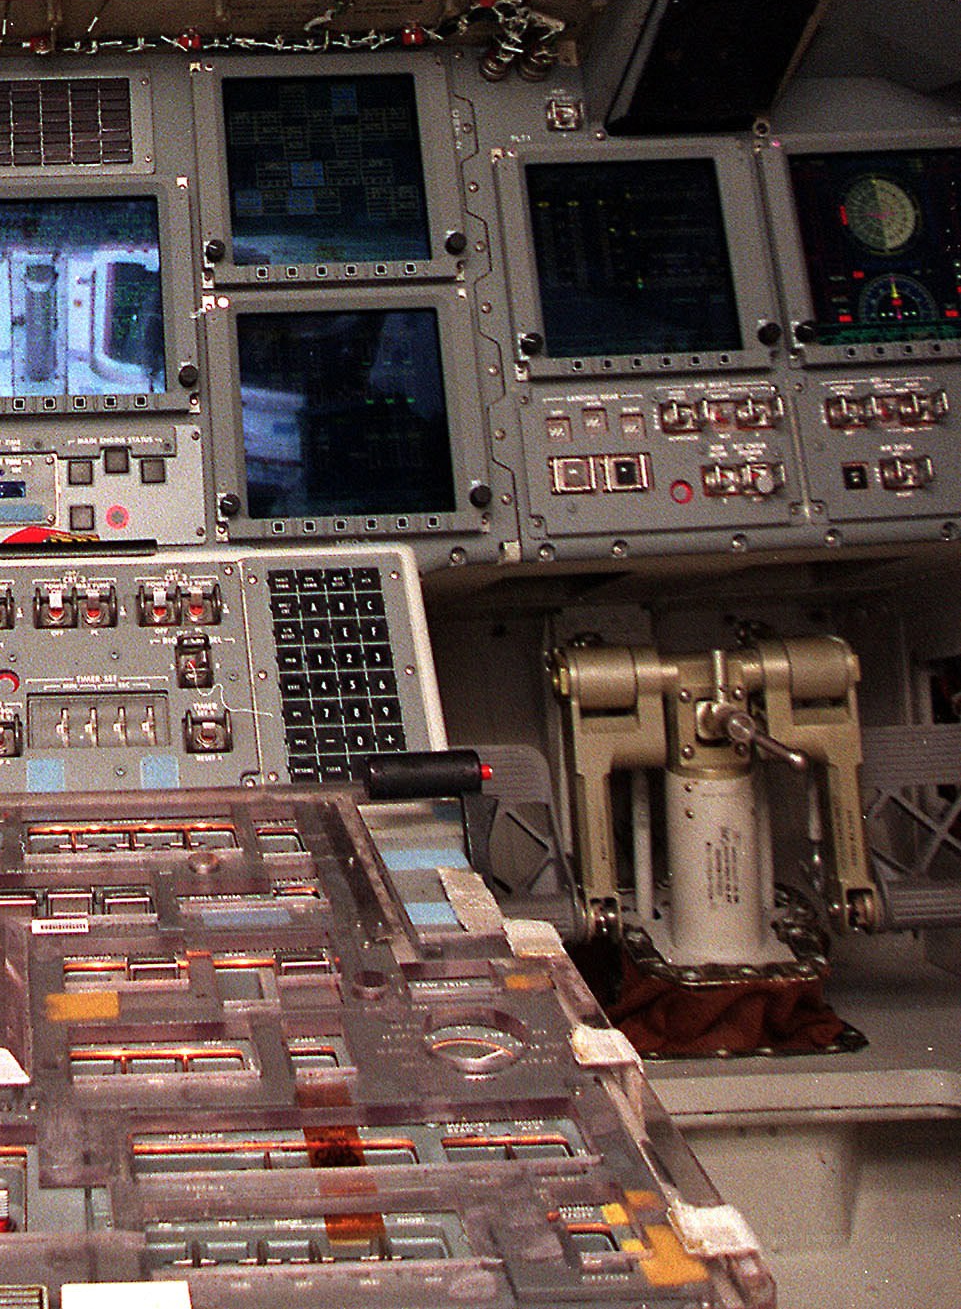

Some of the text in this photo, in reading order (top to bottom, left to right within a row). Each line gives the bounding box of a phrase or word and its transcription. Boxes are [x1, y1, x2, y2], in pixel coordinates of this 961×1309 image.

[311, 602, 317, 612] A
[346, 654, 353, 663] 2
[321, 681, 327, 690] 4
[378, 680, 386, 690] 6
[382, 707, 389, 717] 9
